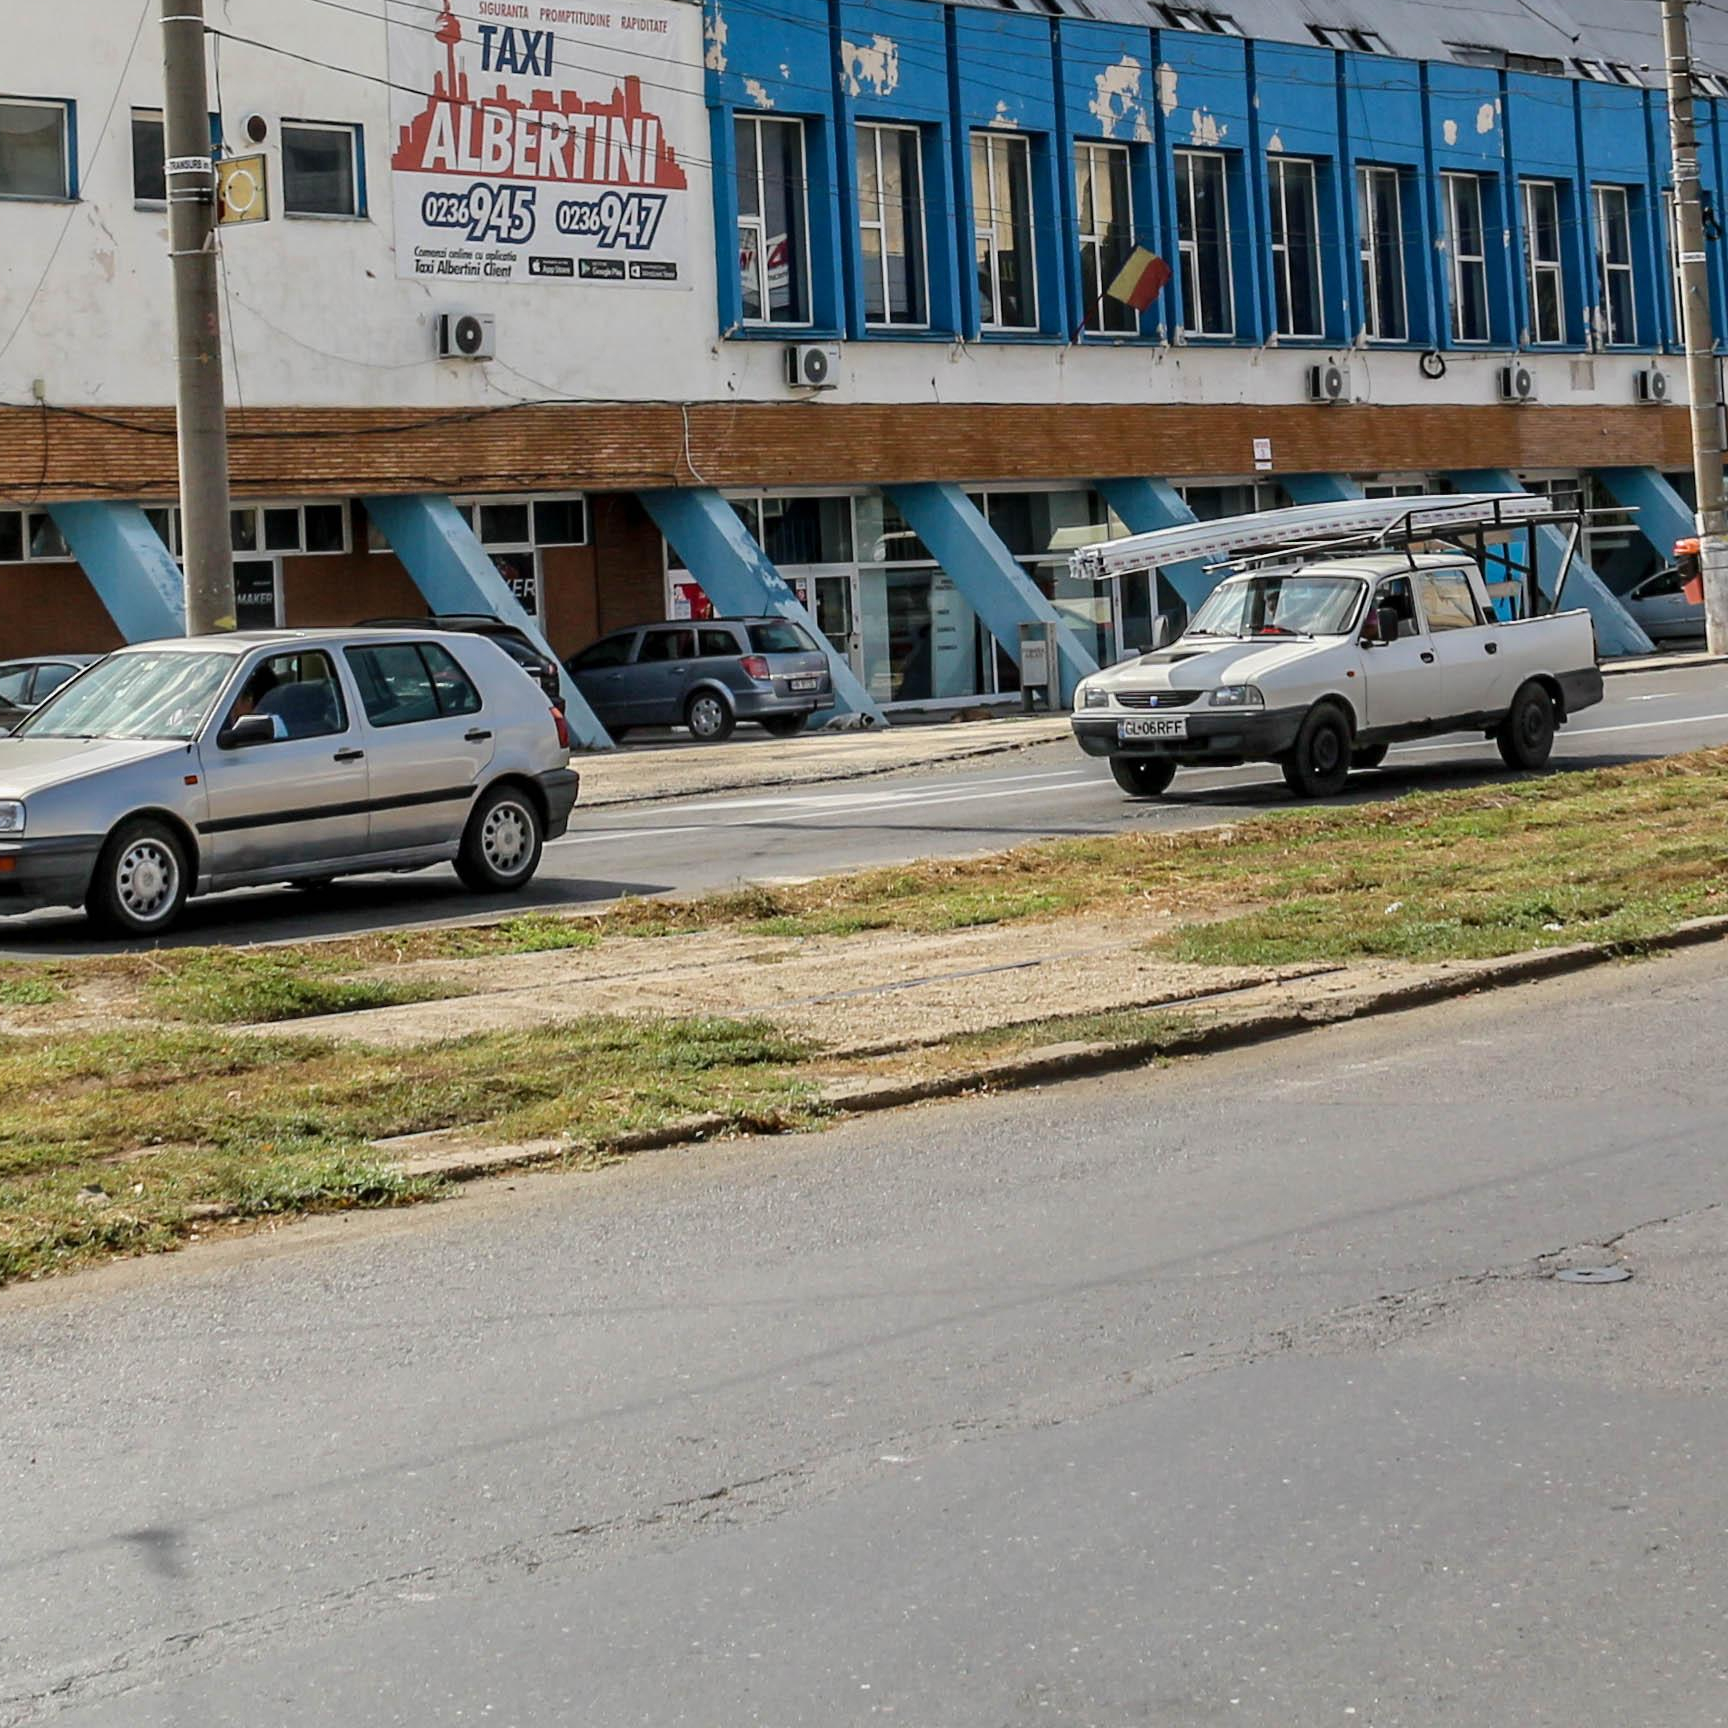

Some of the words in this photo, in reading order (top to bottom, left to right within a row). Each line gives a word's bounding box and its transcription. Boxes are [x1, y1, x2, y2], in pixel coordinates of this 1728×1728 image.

[479, 1, 529, 19] SIGURANTA
[540, 8, 610, 28] PROMPTITUDINE
[621, 16, 668, 33] RAPIDITATE
[478, 24, 554, 77] TAXI
[421, 102, 658, 184] ALBERTINI
[415, 259, 434, 273] Taxi
[437, 260, 480, 275] Albertini
[483, 262, 512, 277] Client
